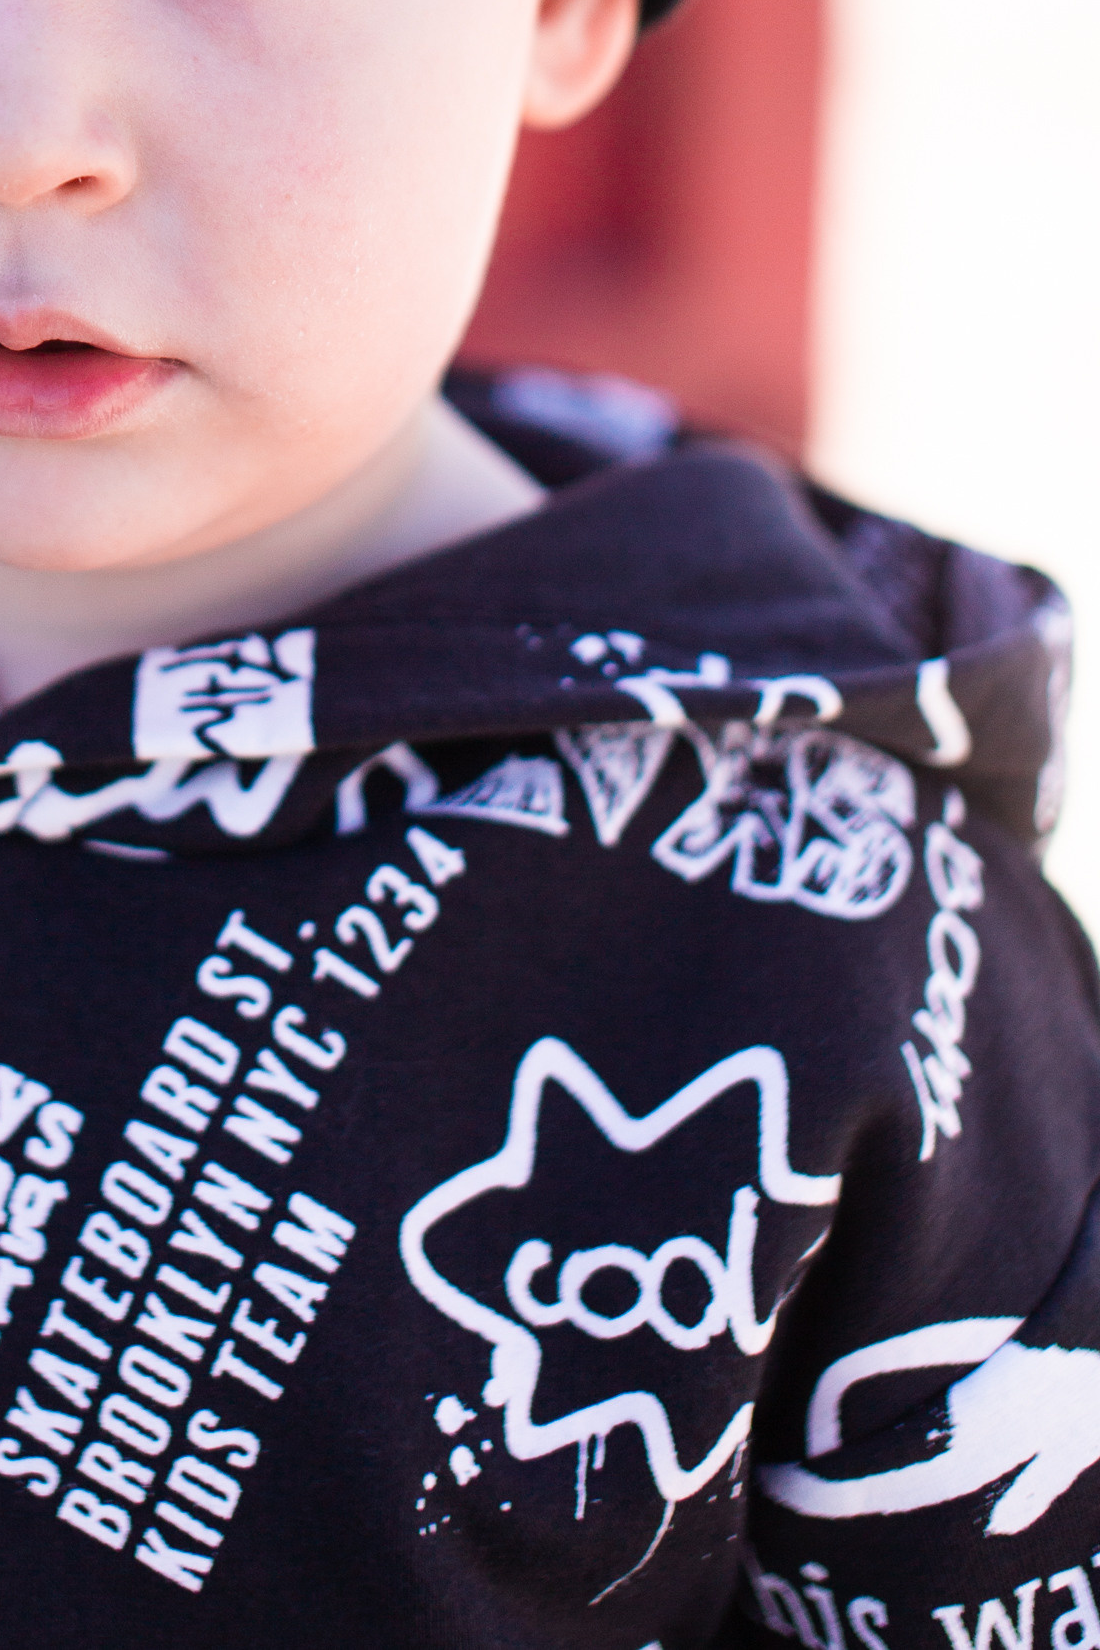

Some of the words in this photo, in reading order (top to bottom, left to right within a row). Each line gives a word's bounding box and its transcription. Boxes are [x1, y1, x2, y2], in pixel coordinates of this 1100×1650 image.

[56, 1160, 273, 1550] BROOKLYN
[223, 1005, 347, 1164] NYC
[313, 826, 466, 998] 1234
[505, 1185, 776, 1355] cool
[134, 1408, 261, 1593] KIDS
[210, 1192, 357, 1400] TEAM
